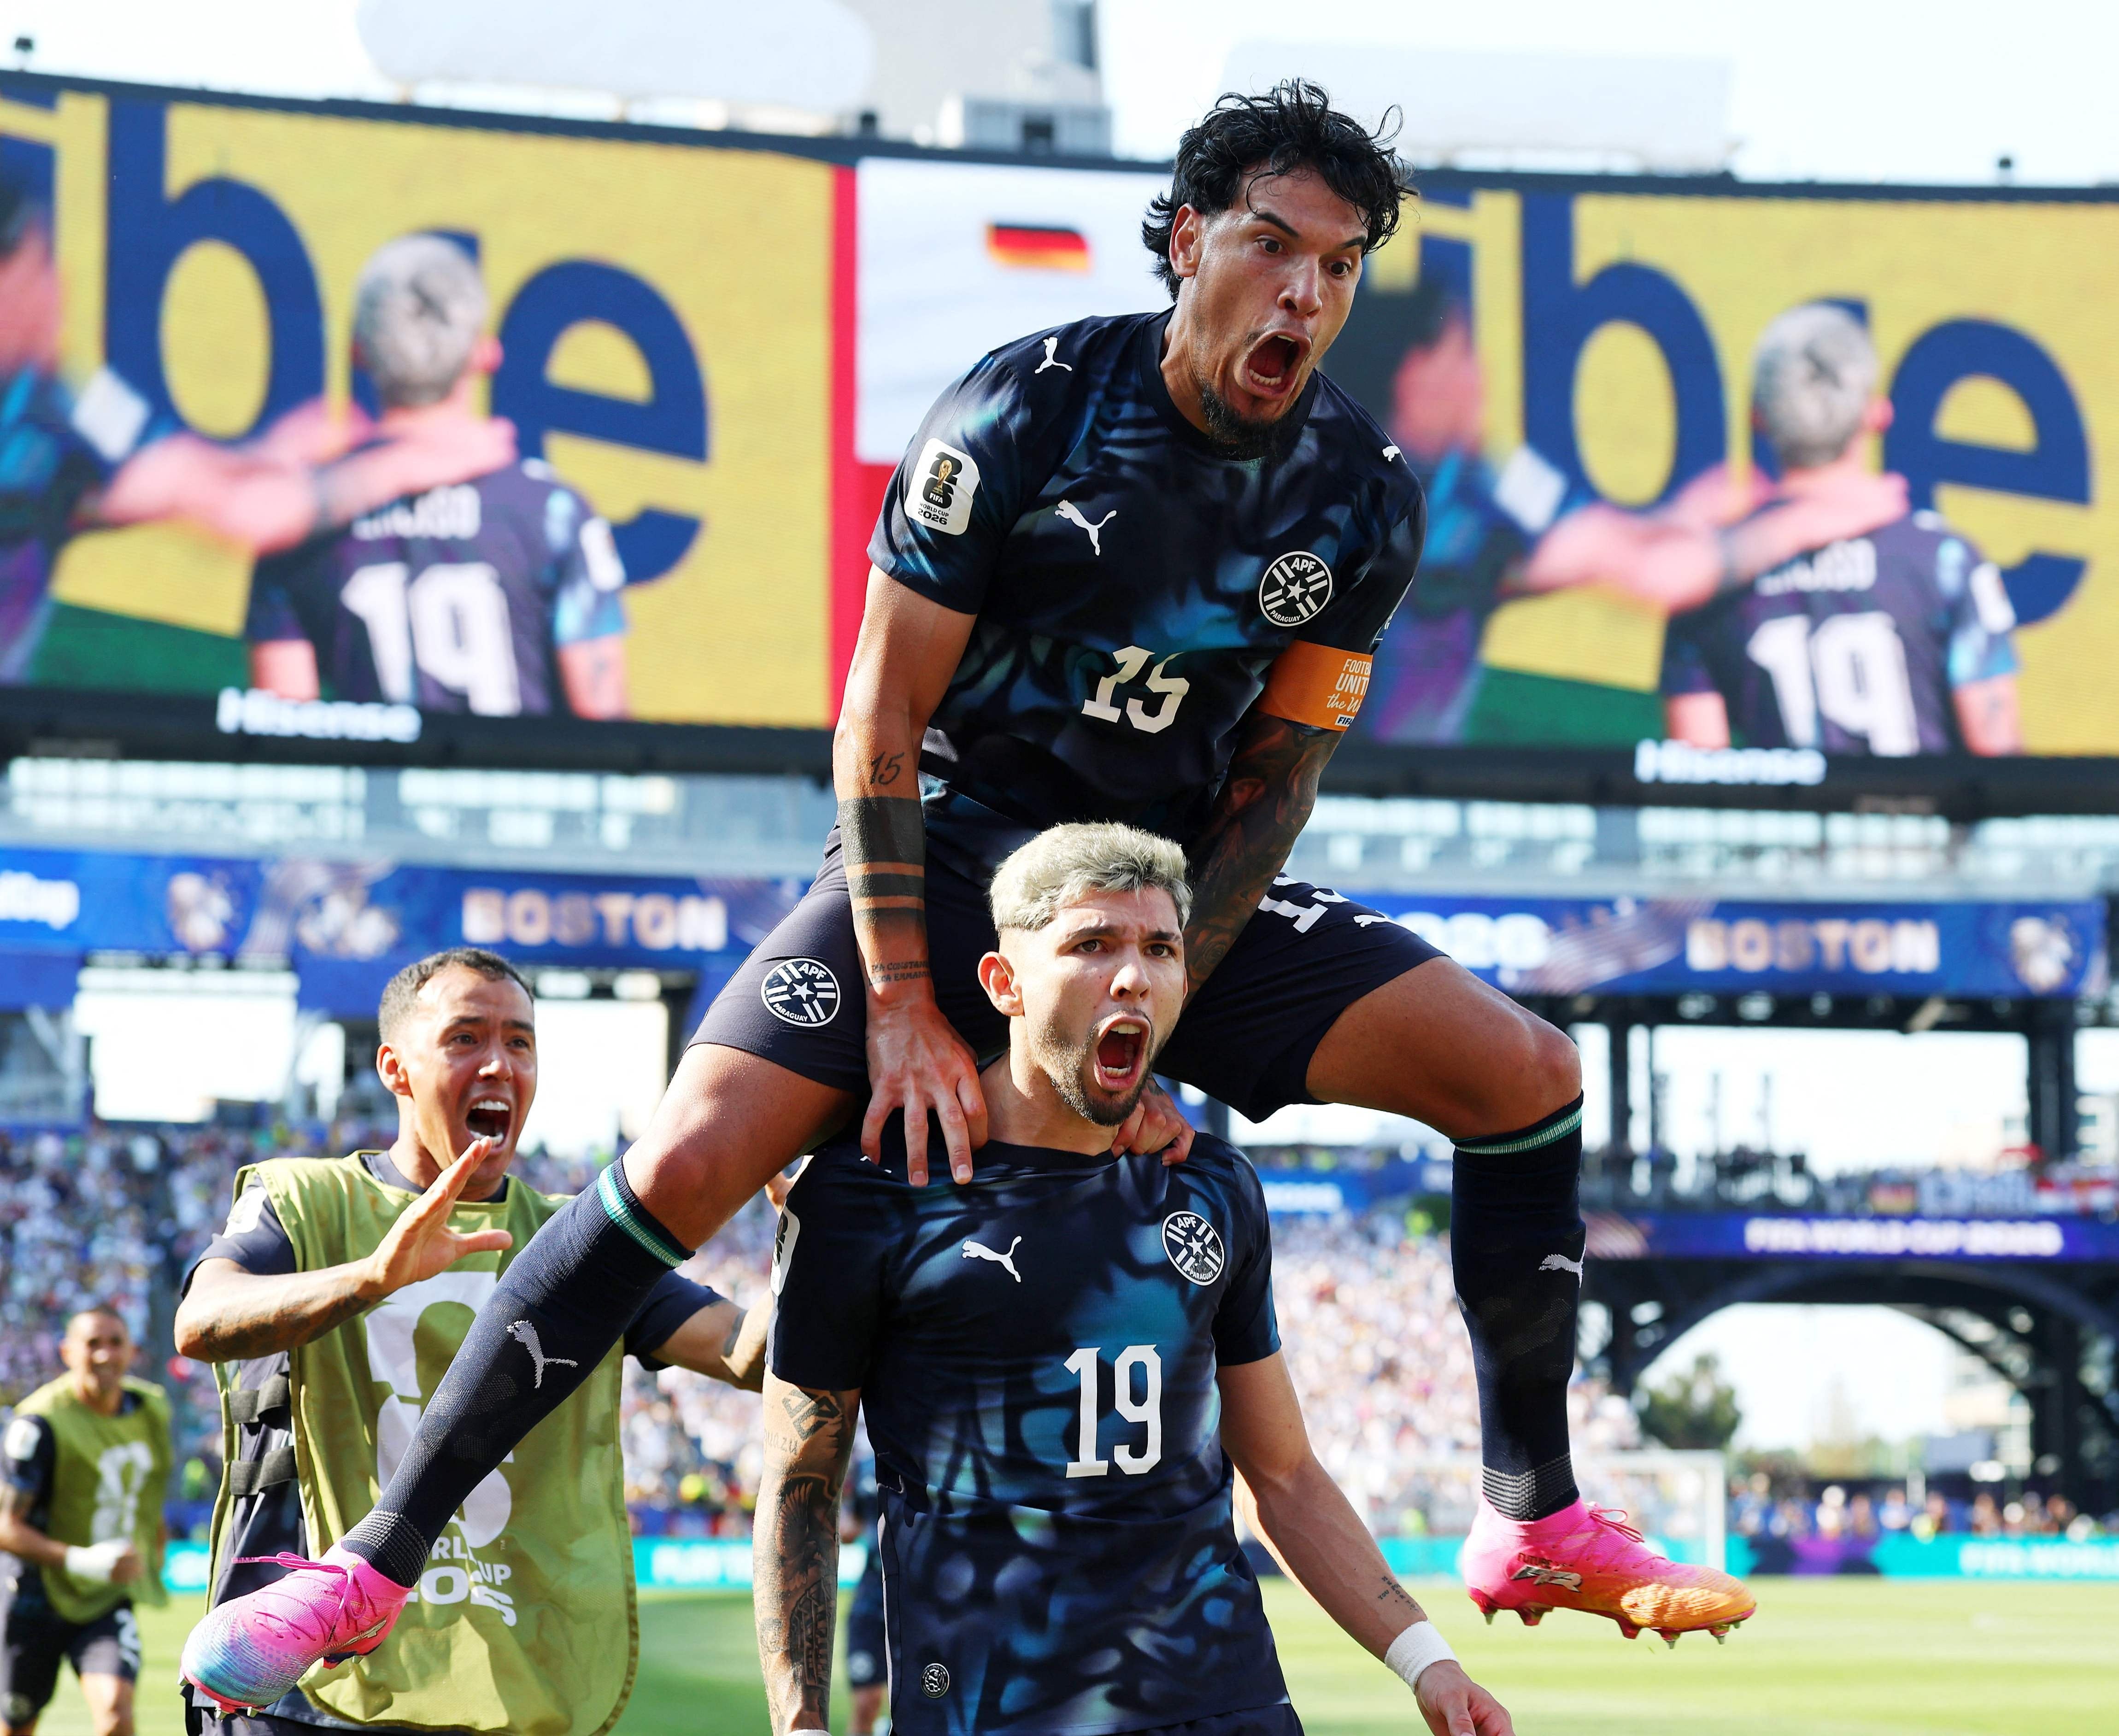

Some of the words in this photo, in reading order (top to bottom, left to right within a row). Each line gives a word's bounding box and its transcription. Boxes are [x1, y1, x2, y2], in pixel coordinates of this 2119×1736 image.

[919, 502, 937, 513] WORLD
[929, 493, 943, 504] FIFA
[918, 508, 948, 525] 2026
[1291, 557, 1316, 573] APF
[1270, 610, 1301, 622] PARAGUAY
[341, 562, 522, 716] 19
[1081, 645, 1190, 734] 15
[1746, 611, 1919, 756] 19
[1327, 693, 1346, 709] the
[1347, 696, 1362, 713] W
[870, 751, 904, 784] 15
[462, 887, 727, 951] BOSTON
[1686, 919, 1939, 973] BOSTON
[798, 962, 827, 980] APF
[773, 1003, 808, 1022] PARAGUAY
[1177, 1217, 1197, 1228] APF
[1190, 1270, 1214, 1280] PARAGUAY
[1063, 1344, 1162, 1478] 19
